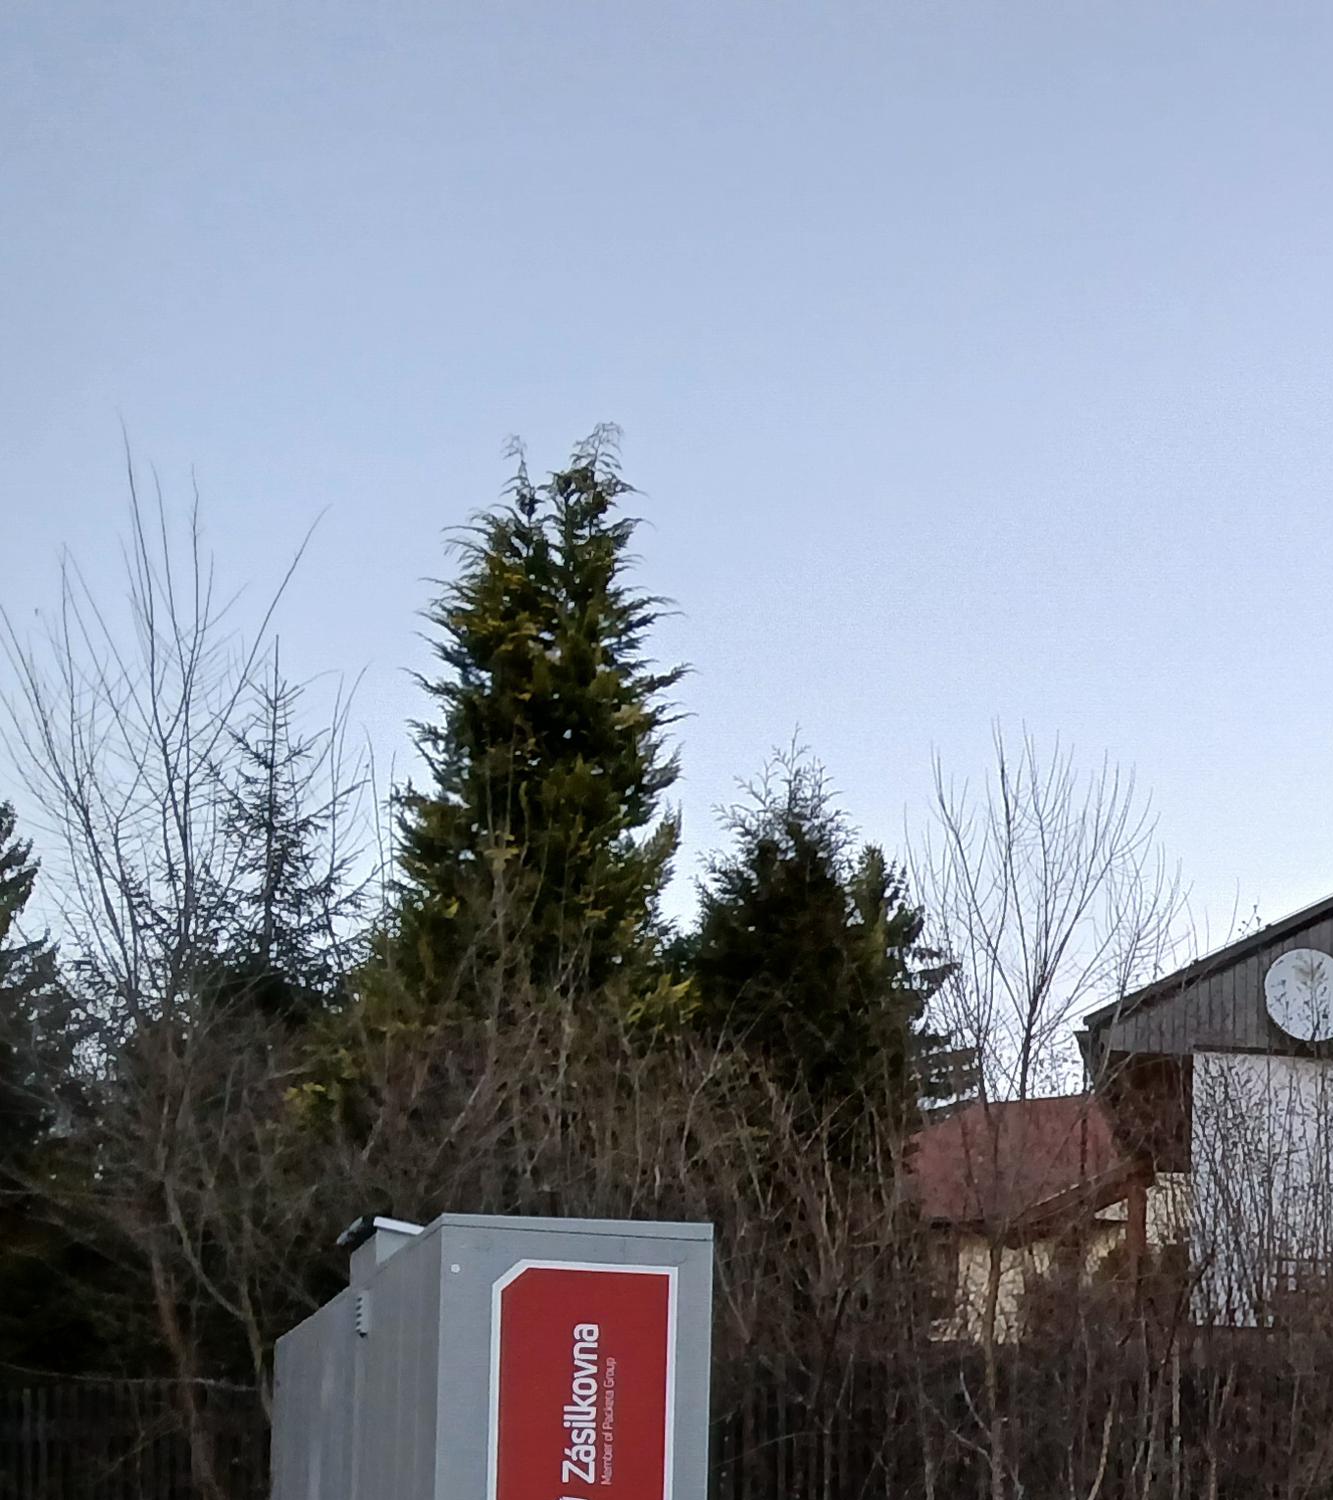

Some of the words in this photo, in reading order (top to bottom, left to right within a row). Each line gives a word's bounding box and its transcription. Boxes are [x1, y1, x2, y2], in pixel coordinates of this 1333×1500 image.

[603, 1357, 617, 1388] Group
[562, 1323, 600, 1484] Zásilkovna
[602, 1431, 613, 1442] of
[601, 1443, 613, 1485] Member
